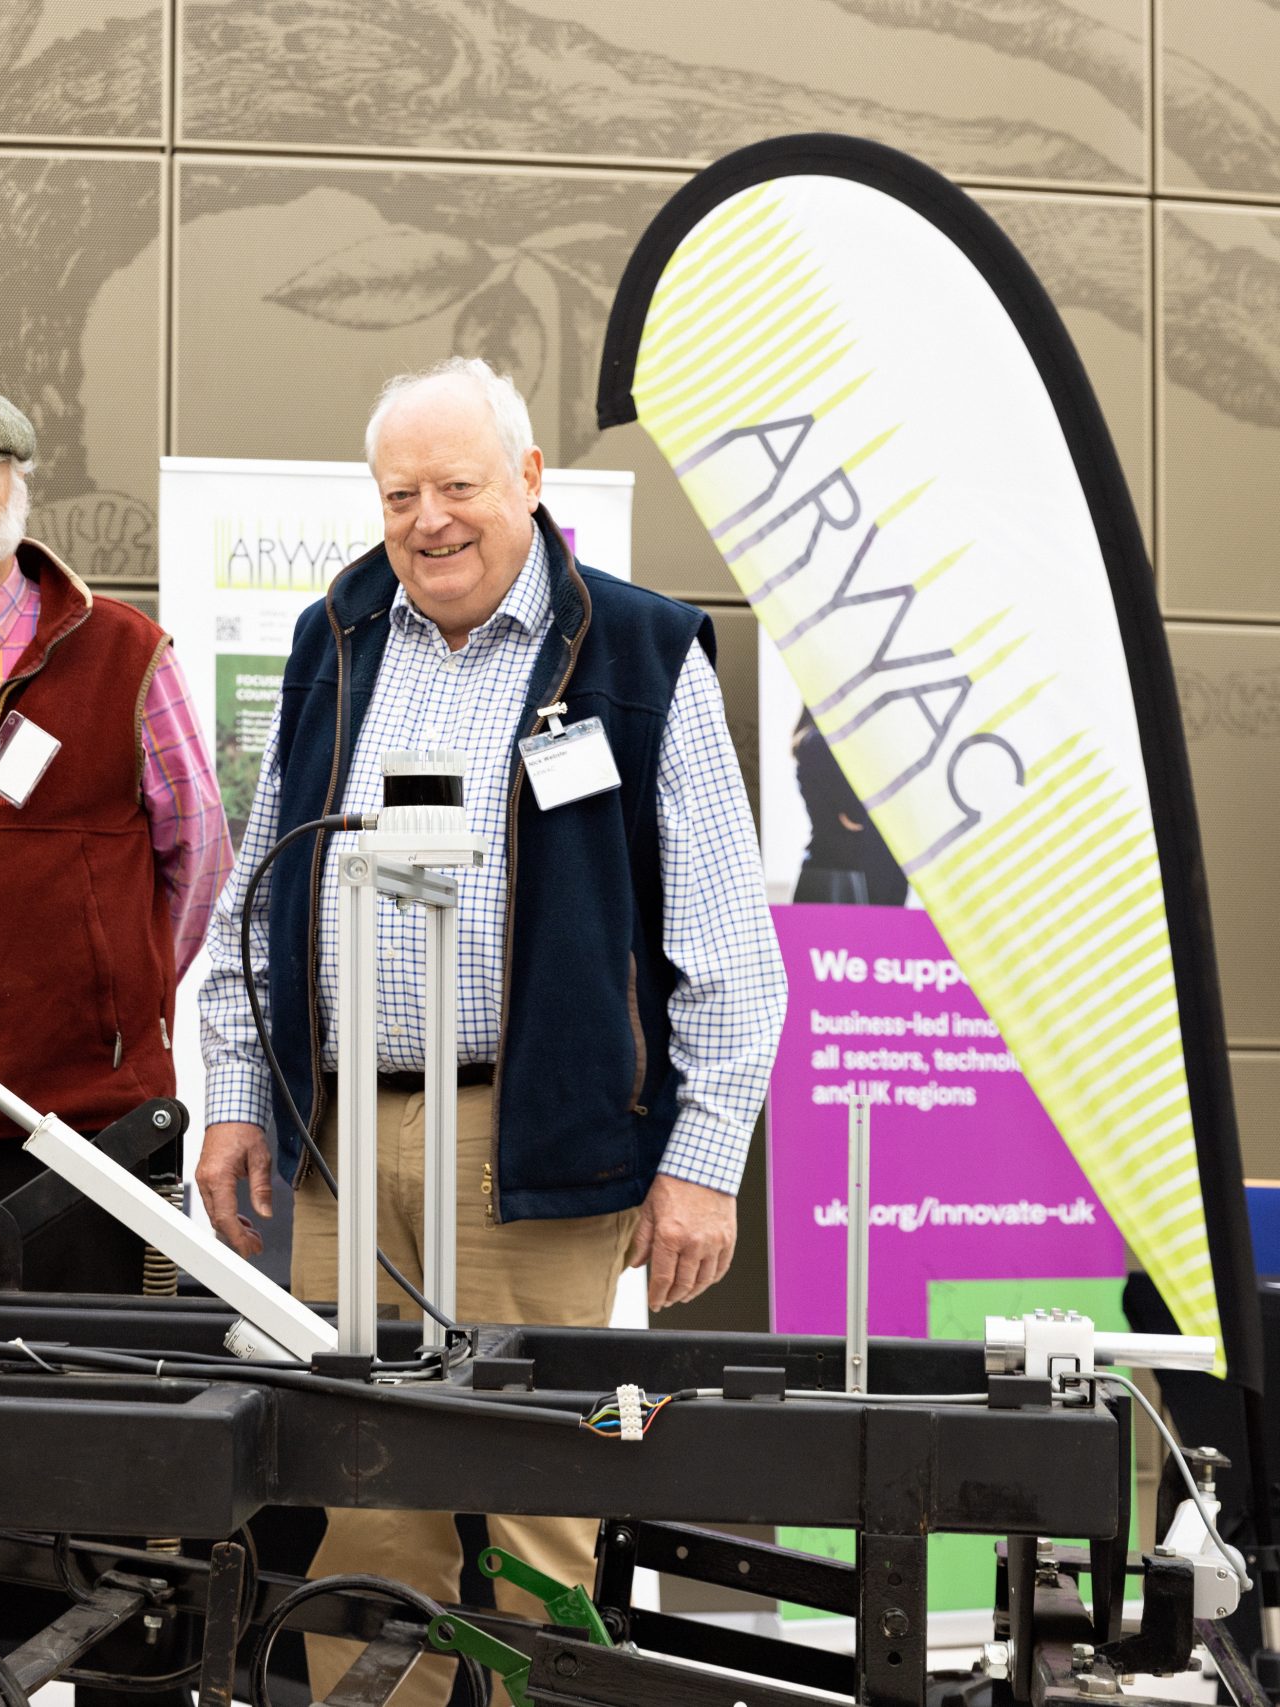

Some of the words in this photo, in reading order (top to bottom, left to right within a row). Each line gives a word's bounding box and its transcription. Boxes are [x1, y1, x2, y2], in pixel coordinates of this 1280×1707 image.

[809, 947, 868, 982] We
[873, 957, 970, 993] supp
[810, 1009, 949, 1037] business-led
[951, 1011, 1001, 1038] inno
[811, 1044, 840, 1070] all
[843, 1047, 930, 1075] sectors,
[933, 1046, 1023, 1072] technol
[812, 1079, 856, 1105] and
[858, 1080, 891, 1105] UK
[894, 1080, 977, 1111] regions
